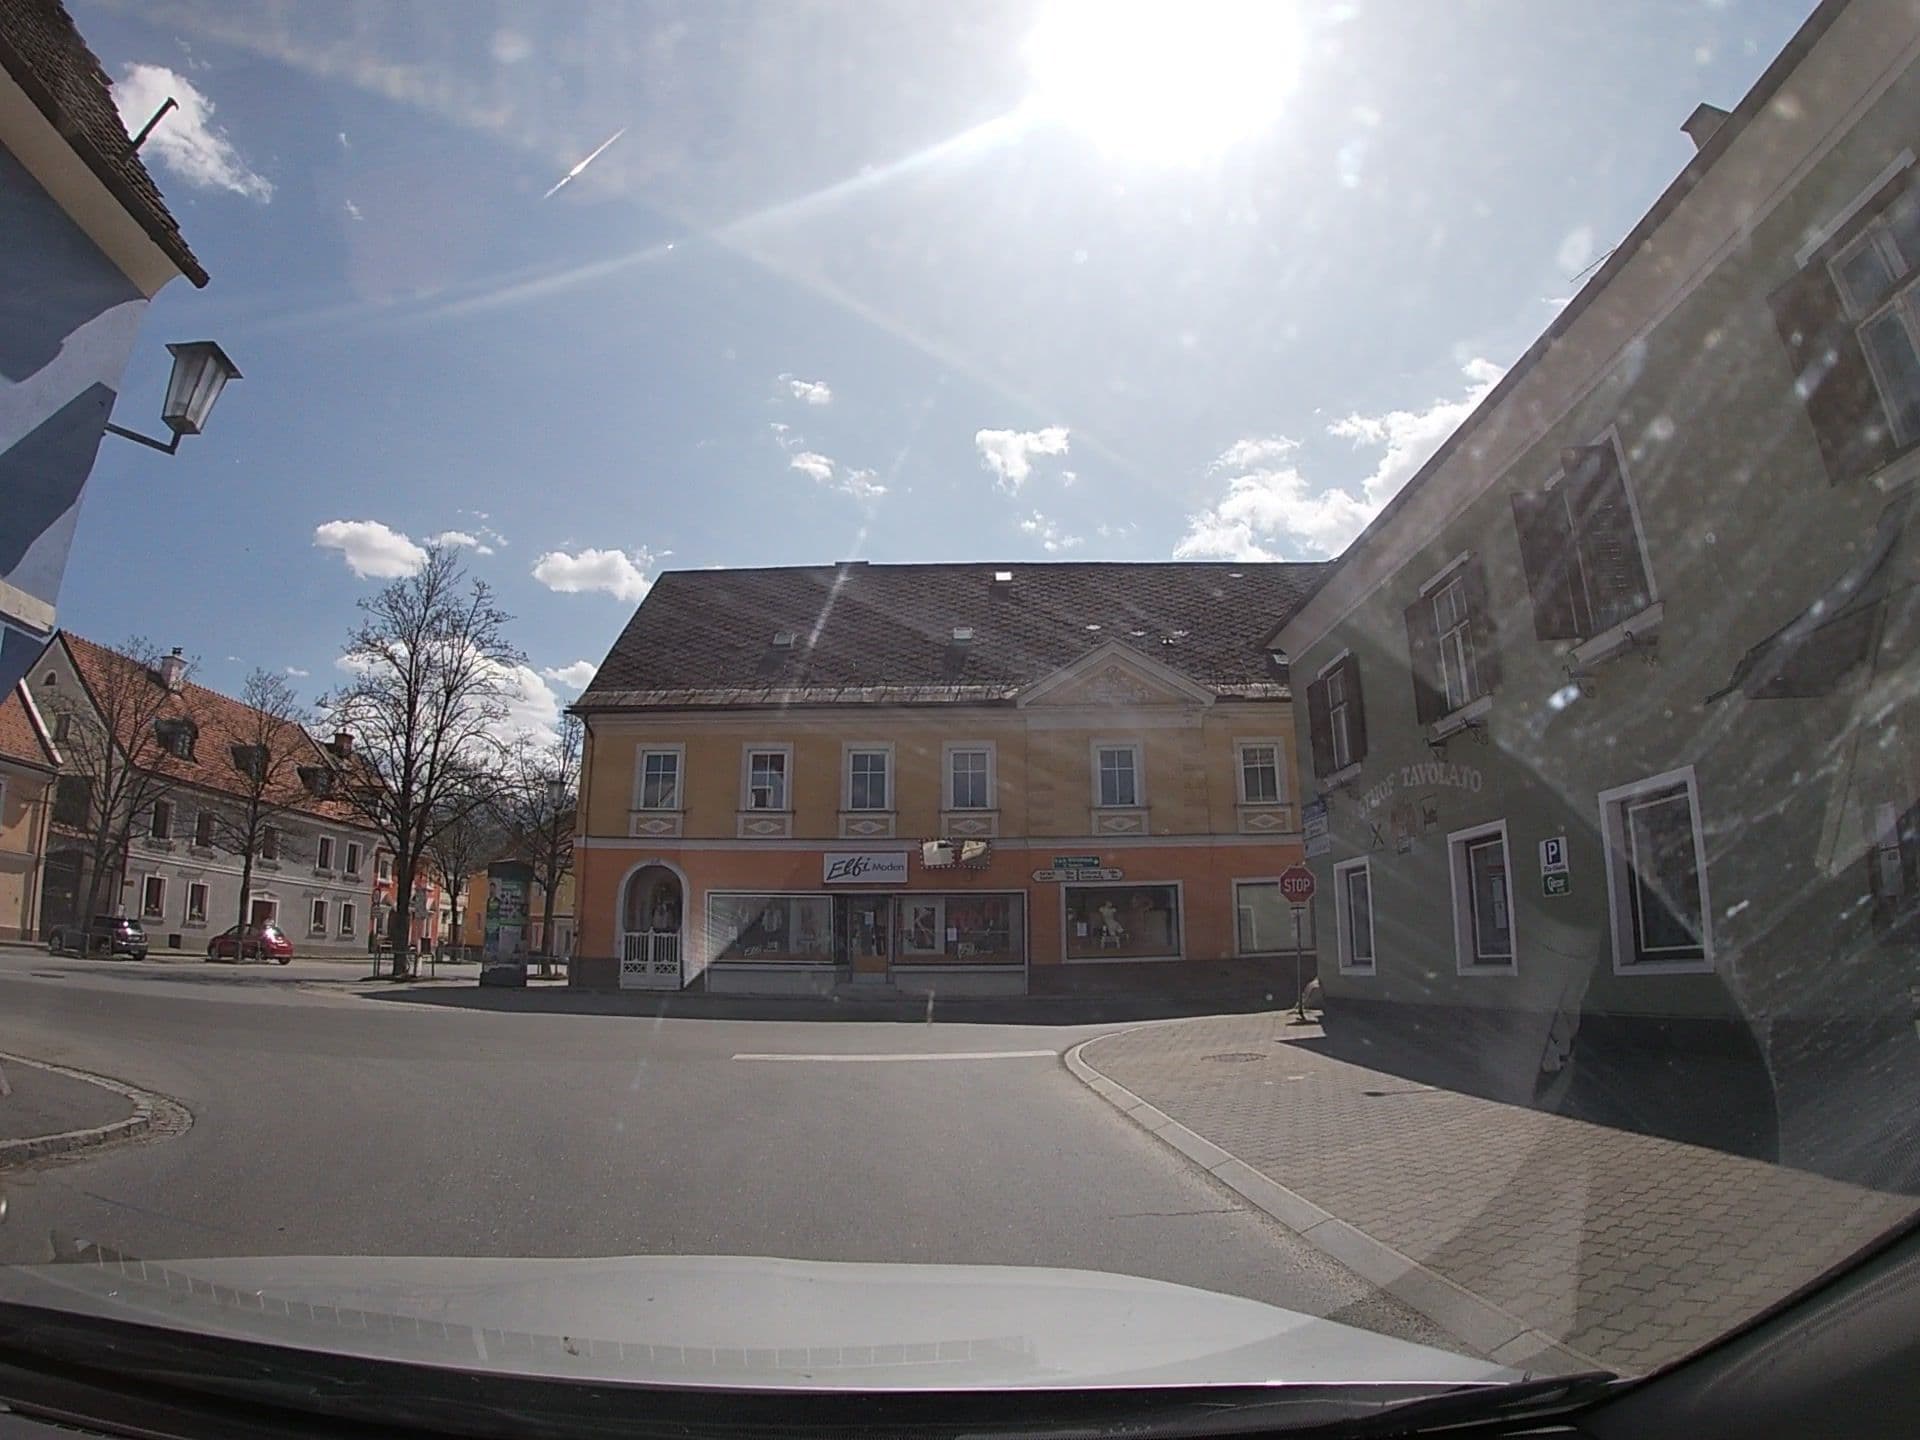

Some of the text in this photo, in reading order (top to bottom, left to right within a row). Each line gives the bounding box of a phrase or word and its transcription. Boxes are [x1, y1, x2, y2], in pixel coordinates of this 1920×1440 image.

[1400, 762, 1483, 793] TAVOLATO
[1547, 841, 1558, 863] P
[826, 856, 904, 880] Elfi Moden
[1284, 879, 1310, 892] STOP
